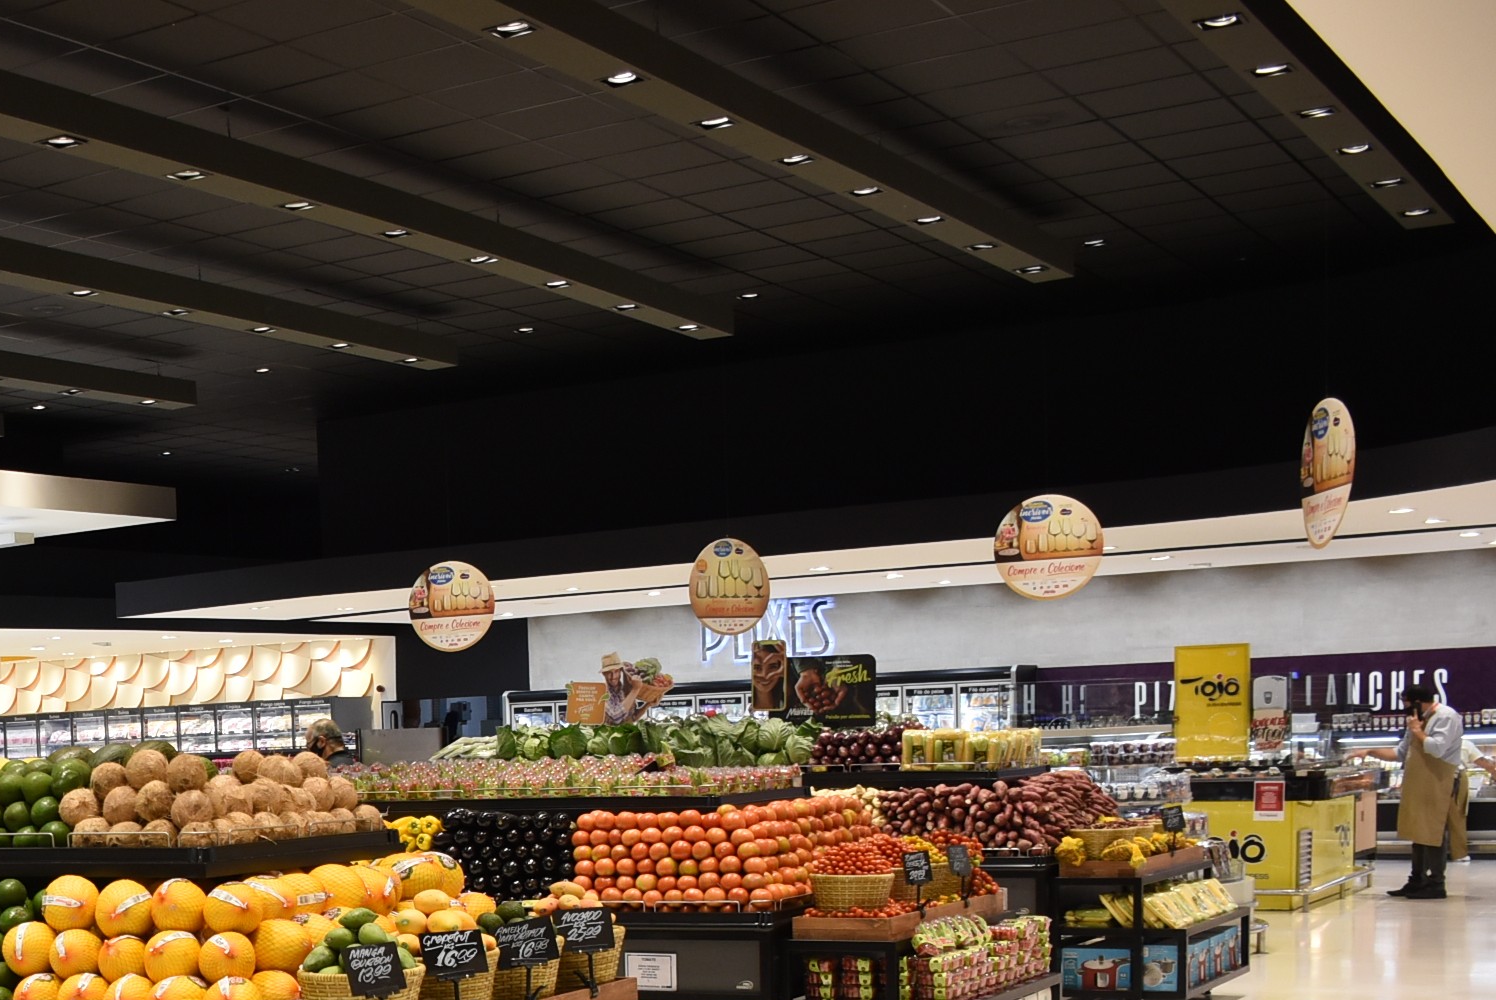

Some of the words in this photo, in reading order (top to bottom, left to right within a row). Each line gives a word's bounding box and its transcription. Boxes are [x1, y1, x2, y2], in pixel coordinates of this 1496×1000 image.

[1007, 565, 1038, 578] Compre
[1047, 562, 1085, 574] Colecione
[420, 621, 444, 633] Compre
[451, 619, 481, 630] Colecione
[349, 946, 386, 961] MANGA
